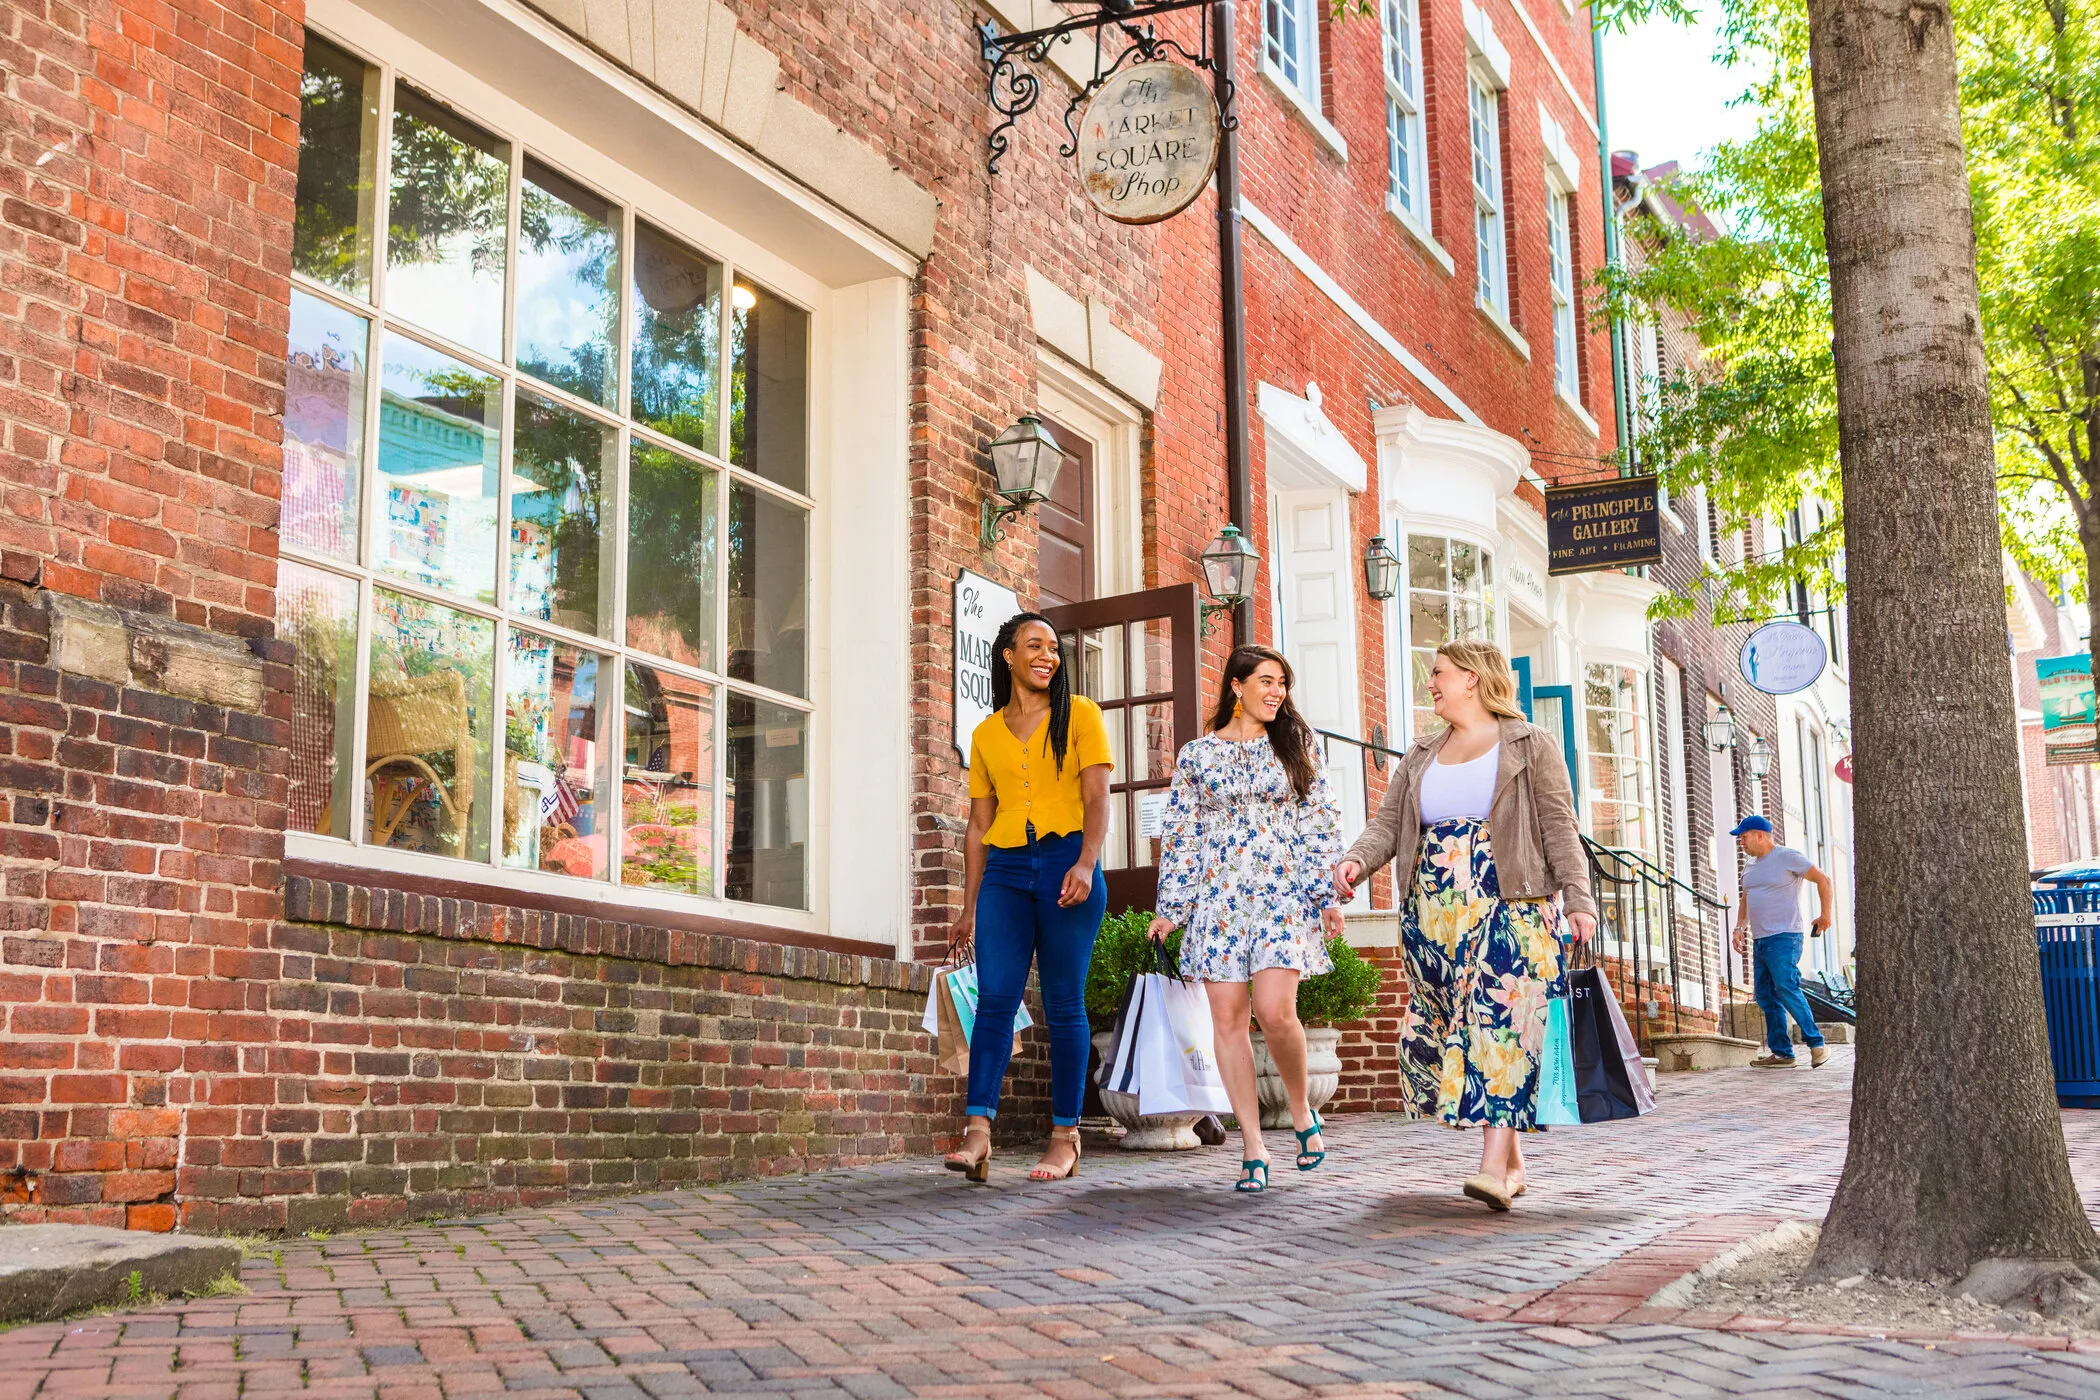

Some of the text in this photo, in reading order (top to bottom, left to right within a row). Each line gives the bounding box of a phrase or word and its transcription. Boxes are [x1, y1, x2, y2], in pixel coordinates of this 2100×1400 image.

[1121, 77, 1165, 107] Th
[1094, 137, 1198, 173] SQUARE
[1110, 171, 1180, 201] Shop
[1551, 496, 1654, 522] The PRINCIPLE
[1572, 517, 1640, 541] GALLERY
[1552, 537, 1656, 559] FINE ART FRAMING
[963, 586, 983, 618] The
[959, 630, 992, 672] MAR
[959, 668, 993, 709] SQU
[2039, 676, 2060, 687] OLD
